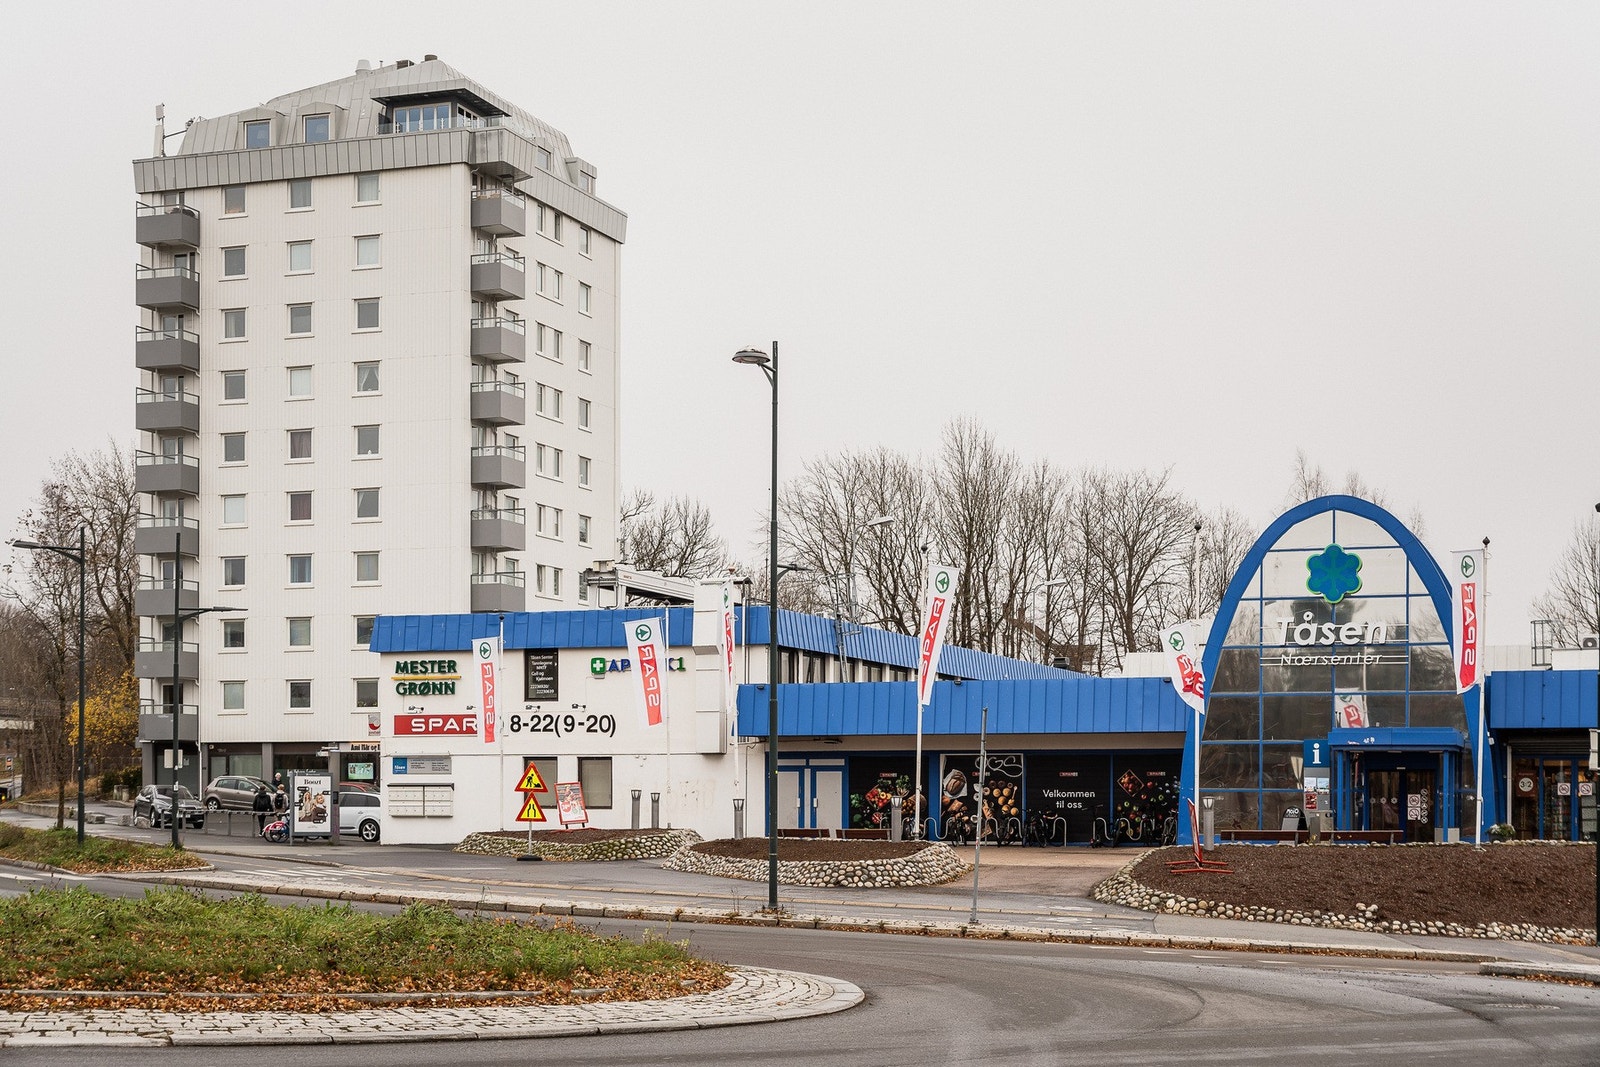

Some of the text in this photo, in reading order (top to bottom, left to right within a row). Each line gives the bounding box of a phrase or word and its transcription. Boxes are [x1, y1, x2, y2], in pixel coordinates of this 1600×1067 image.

[1276, 611, 1388, 646] Tåsen
[608, 656, 686, 673] APK1
[1280, 652, 1383, 667] Nærsenter
[395, 660, 457, 674] MESTER
[395, 681, 456, 695] GRØNN
[411, 717, 477, 732] SPAR
[1042, 789, 1096, 798] Velkommen
[1056, 801, 1064, 809] til
